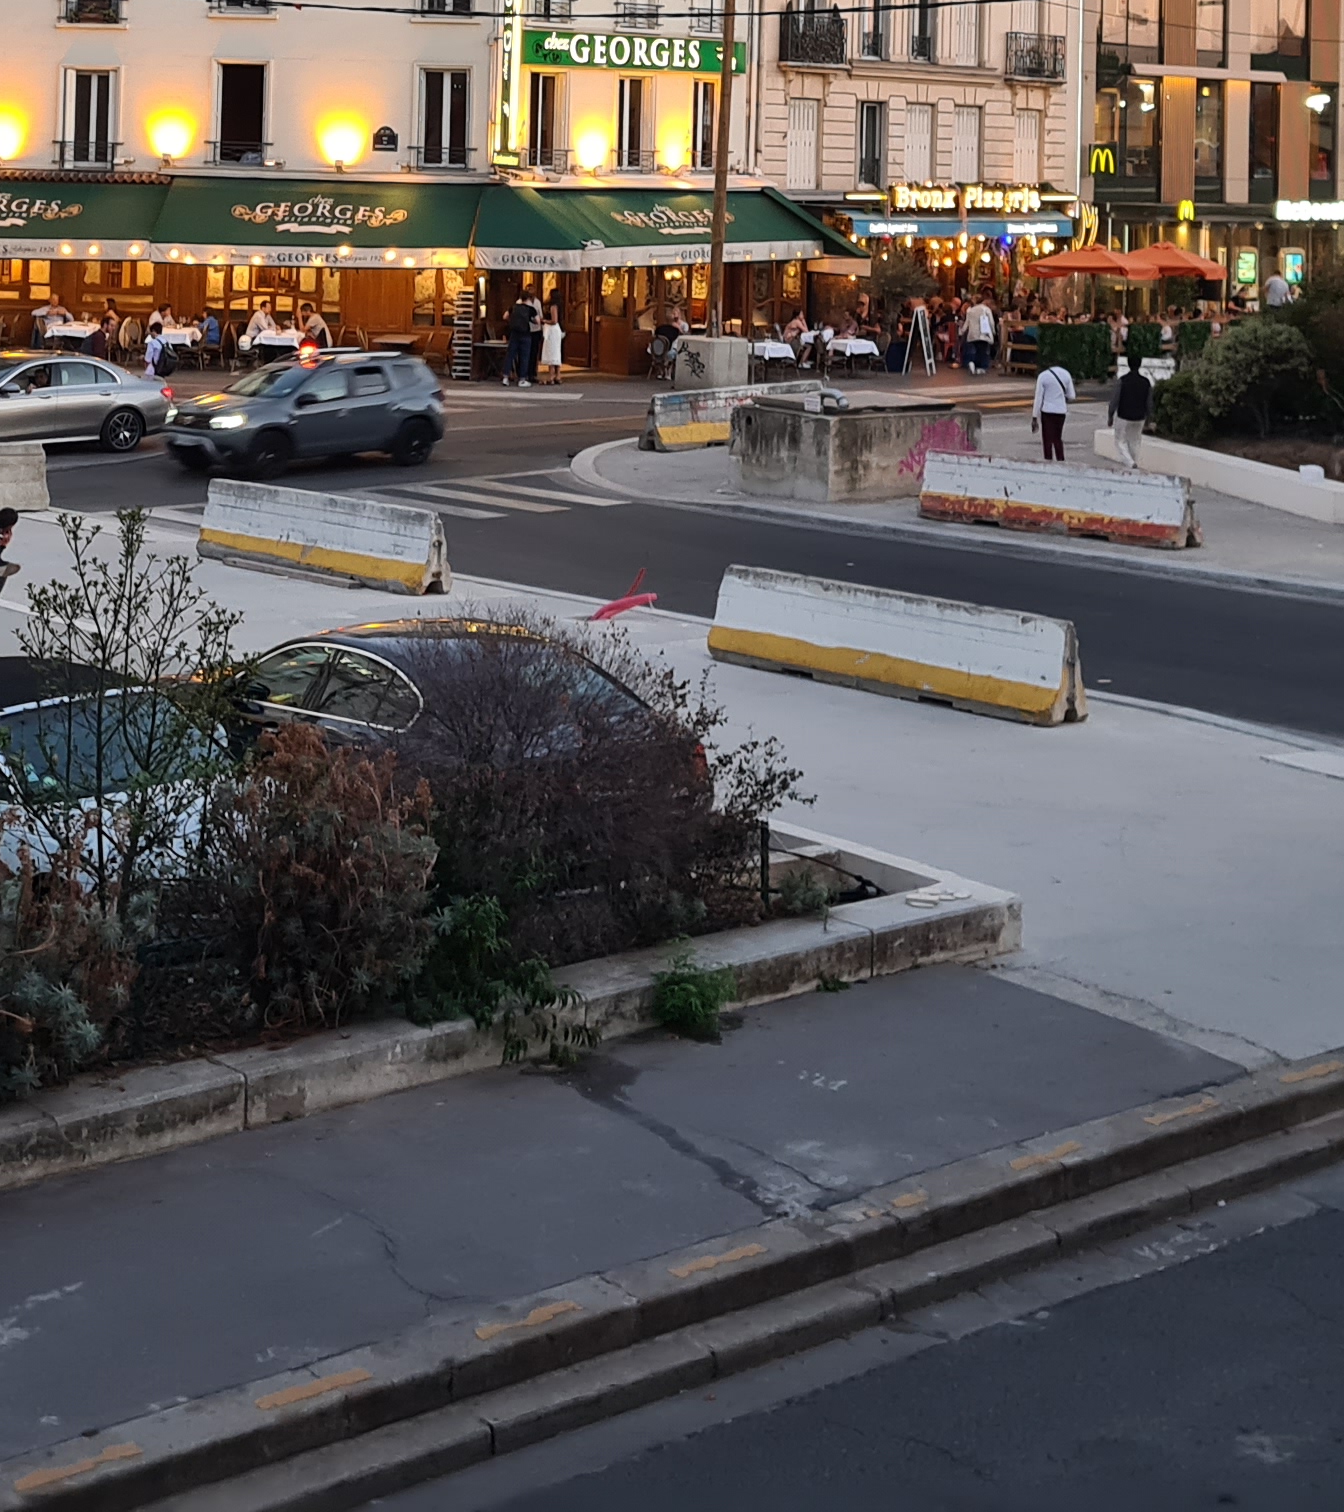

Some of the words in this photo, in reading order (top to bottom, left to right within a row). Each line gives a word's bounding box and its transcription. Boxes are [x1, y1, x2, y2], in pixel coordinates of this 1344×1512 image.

[544, 32, 570, 50] chez
[570, 34, 700, 69] GEORGES
[895, 185, 956, 208] Bronx
[256, 202, 386, 221] GEORGES
